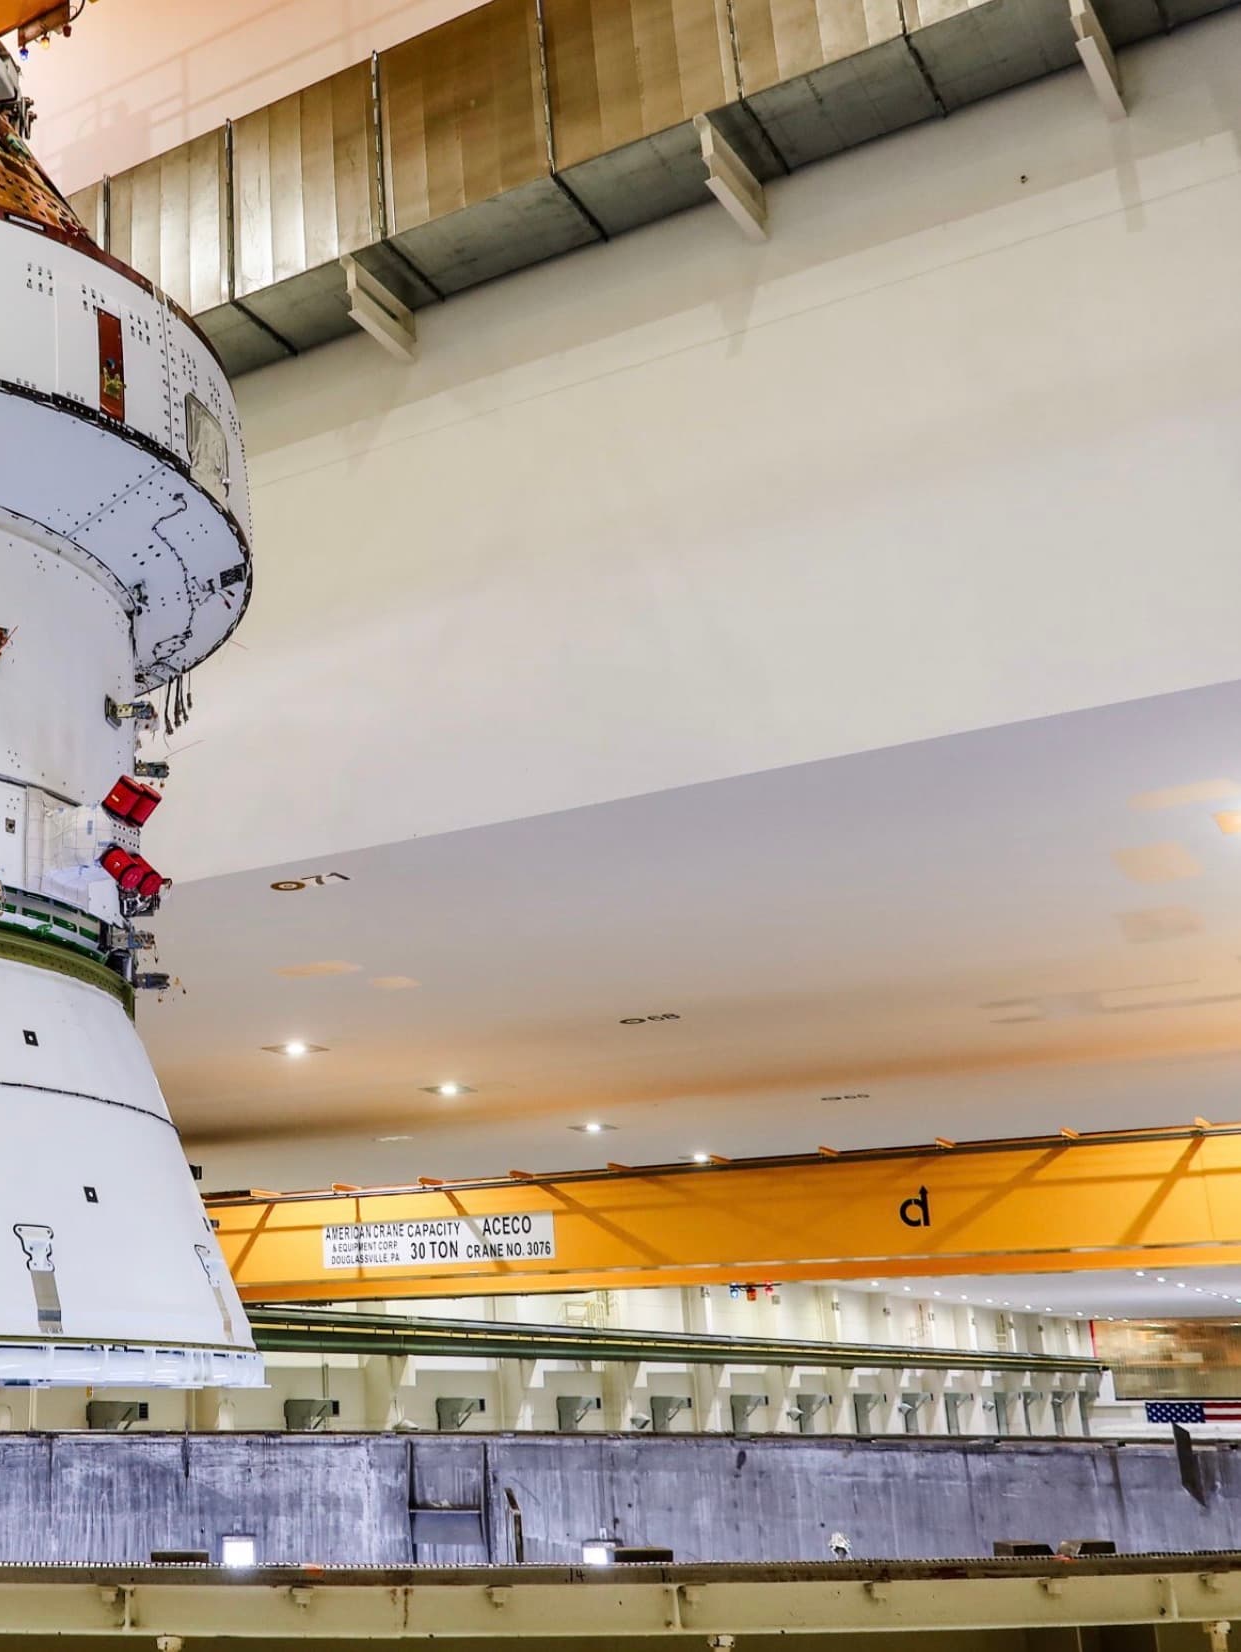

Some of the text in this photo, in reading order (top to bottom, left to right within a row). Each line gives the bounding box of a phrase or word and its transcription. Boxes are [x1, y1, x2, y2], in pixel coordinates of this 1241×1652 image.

[325, 1223, 405, 1241] AMERICAN CRANE
[408, 1222, 460, 1238] CAPACITY
[482, 1215, 532, 1236] ACECO
[339, 1241, 377, 1252] EQUIPMENT
[411, 1240, 459, 1260] 30 TON
[466, 1240, 552, 1258] CRANE NO. 3076
[390, 1251, 400, 1262] PA
